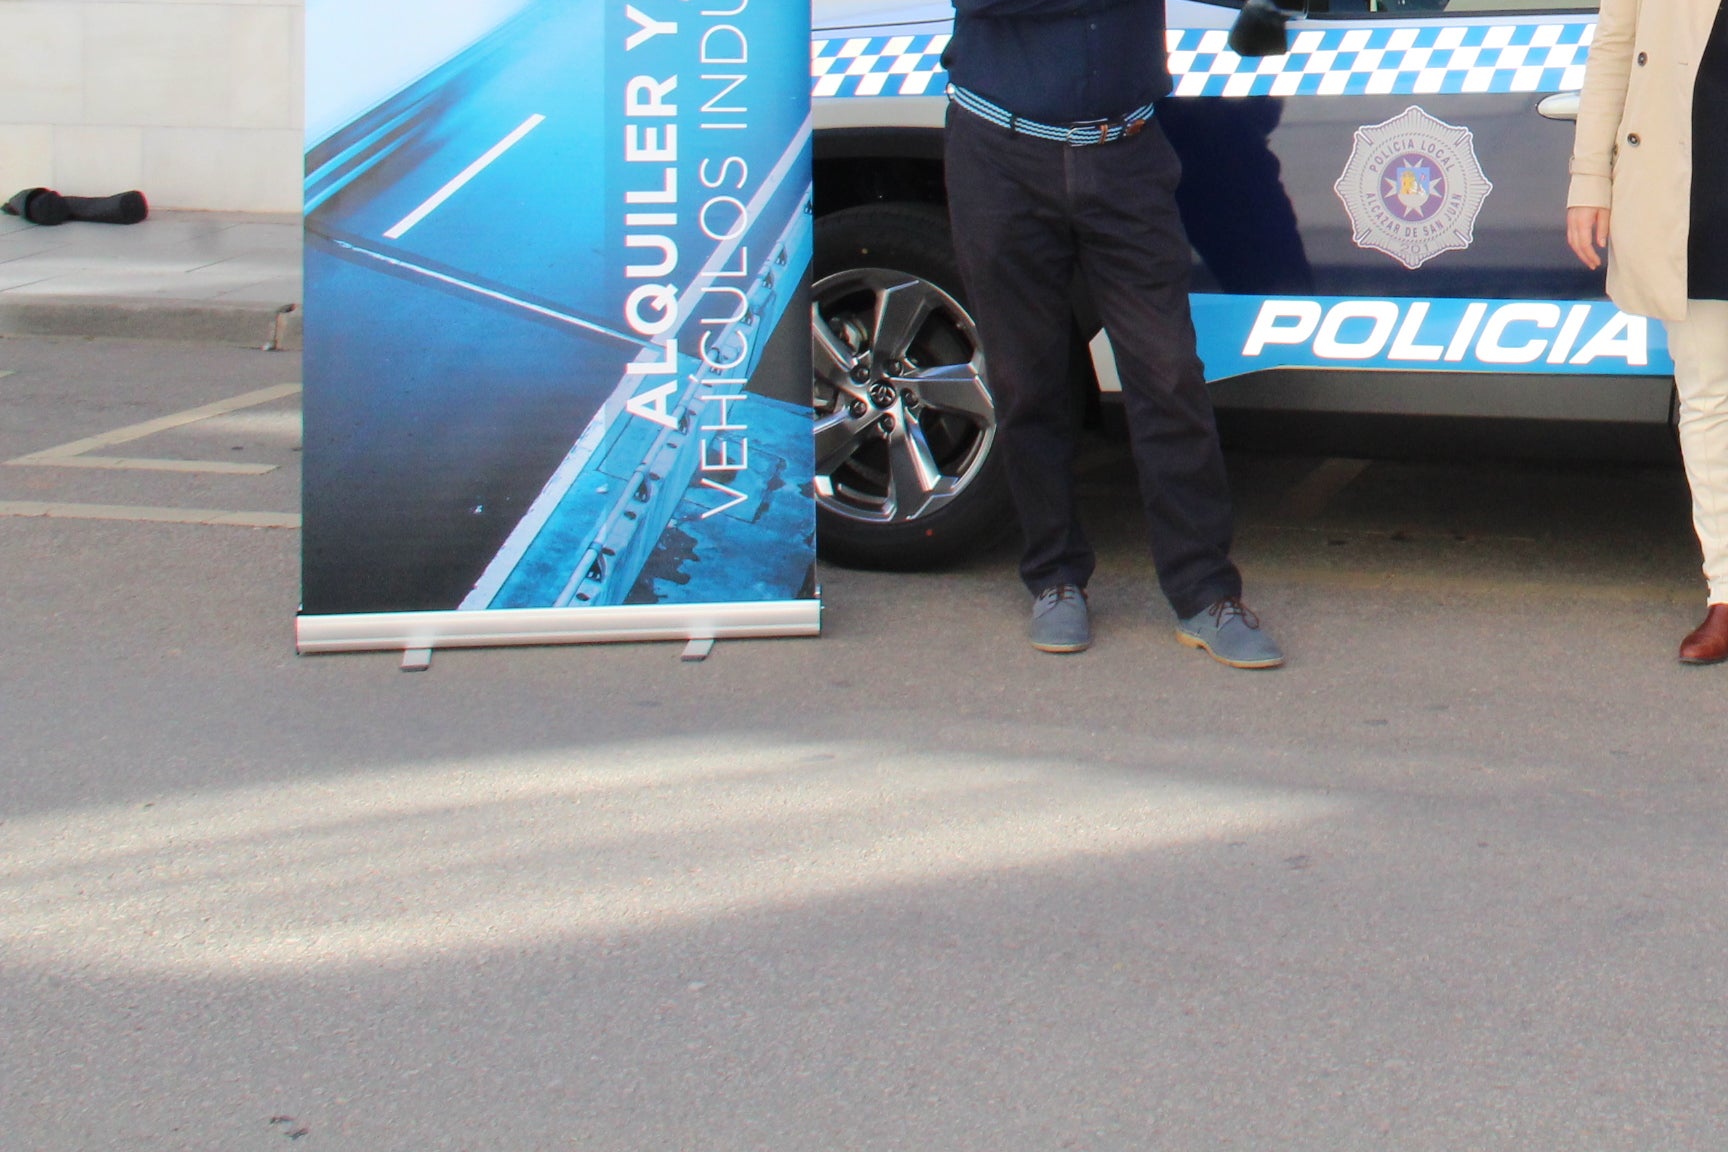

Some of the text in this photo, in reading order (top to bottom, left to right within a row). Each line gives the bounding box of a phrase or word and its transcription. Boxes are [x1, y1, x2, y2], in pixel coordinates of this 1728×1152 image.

[626, 4, 678, 51] Y
[1369, 139, 1455, 173] POLICIA LOCAL
[1366, 192, 1462, 238] ALCAZAR DE SAN JUAN
[625, 74, 679, 430] ALQUILER
[689, 155, 749, 519] VEHÍCULOS
[1242, 298, 1648, 366] POLICIA
